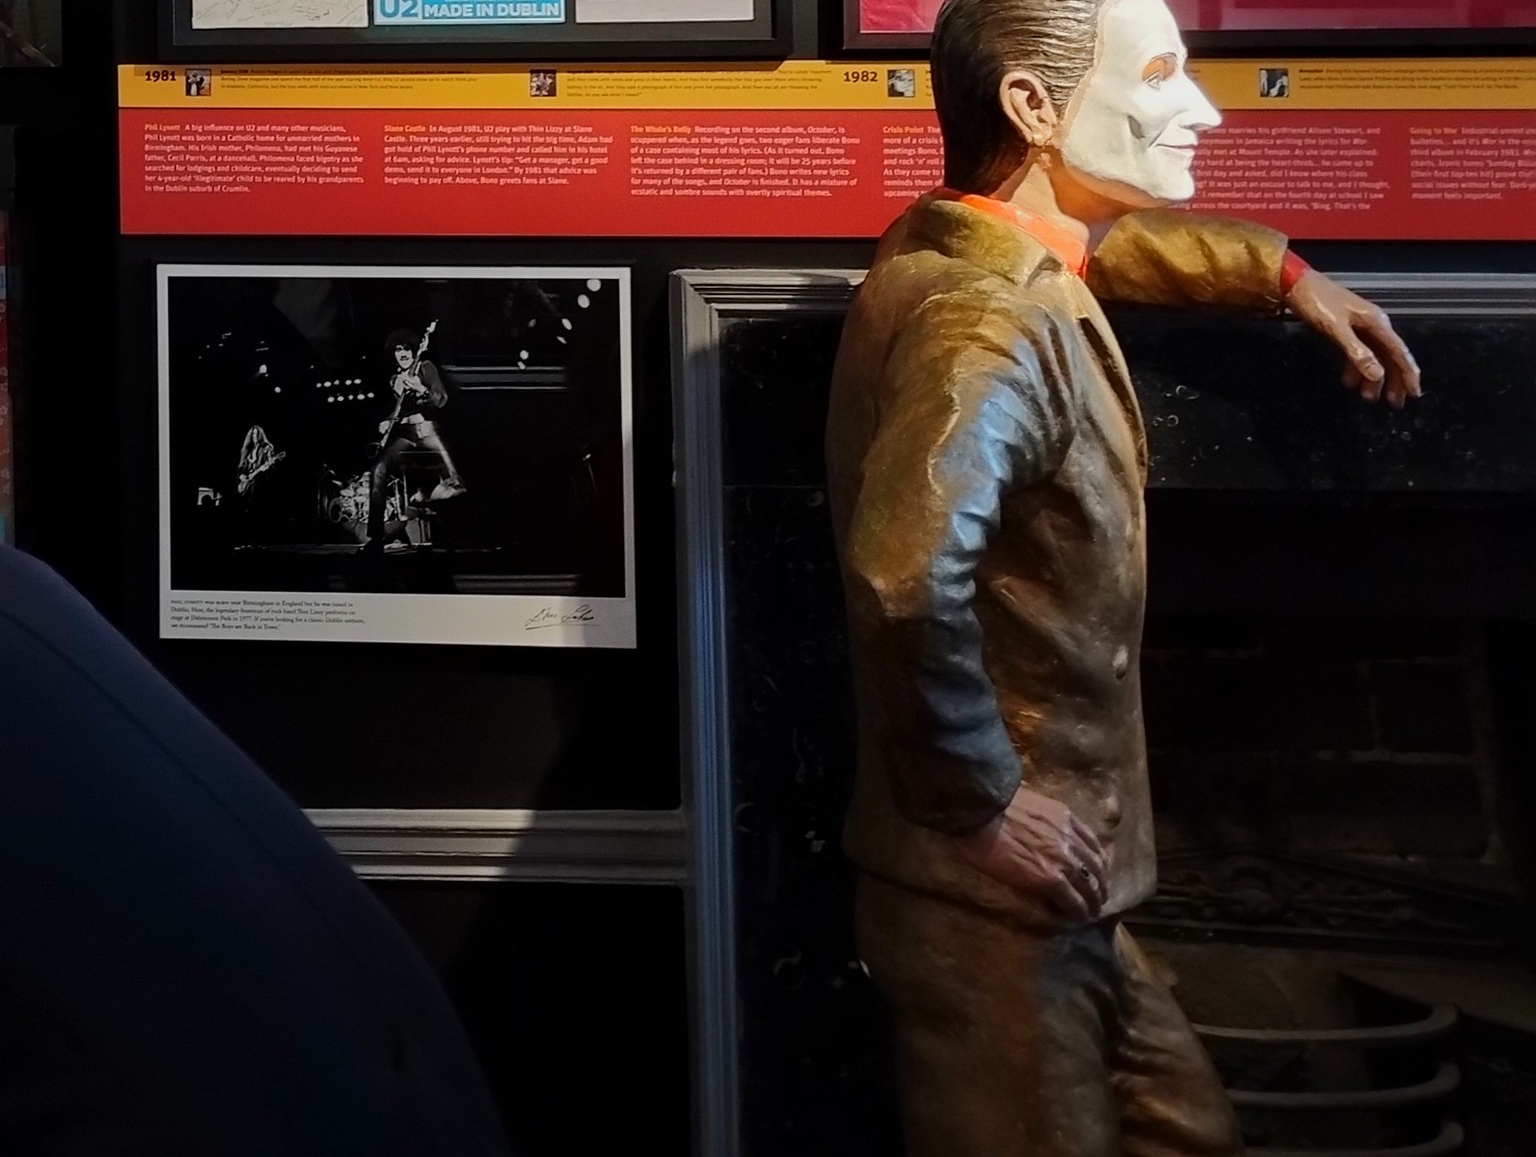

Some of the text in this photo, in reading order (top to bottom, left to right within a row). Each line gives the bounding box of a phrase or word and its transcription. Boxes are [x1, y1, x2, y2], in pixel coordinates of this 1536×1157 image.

[424, 3, 473, 18] MADE
[476, 3, 494, 17] IN
[497, 2, 560, 17] DUBLIN
[144, 69, 177, 83] 1981
[843, 69, 878, 84] 1982
[246, 124, 255, 132] U2
[256, 124, 270, 132] and
[271, 125, 289, 134] many
[290, 124, 309, 132] other
